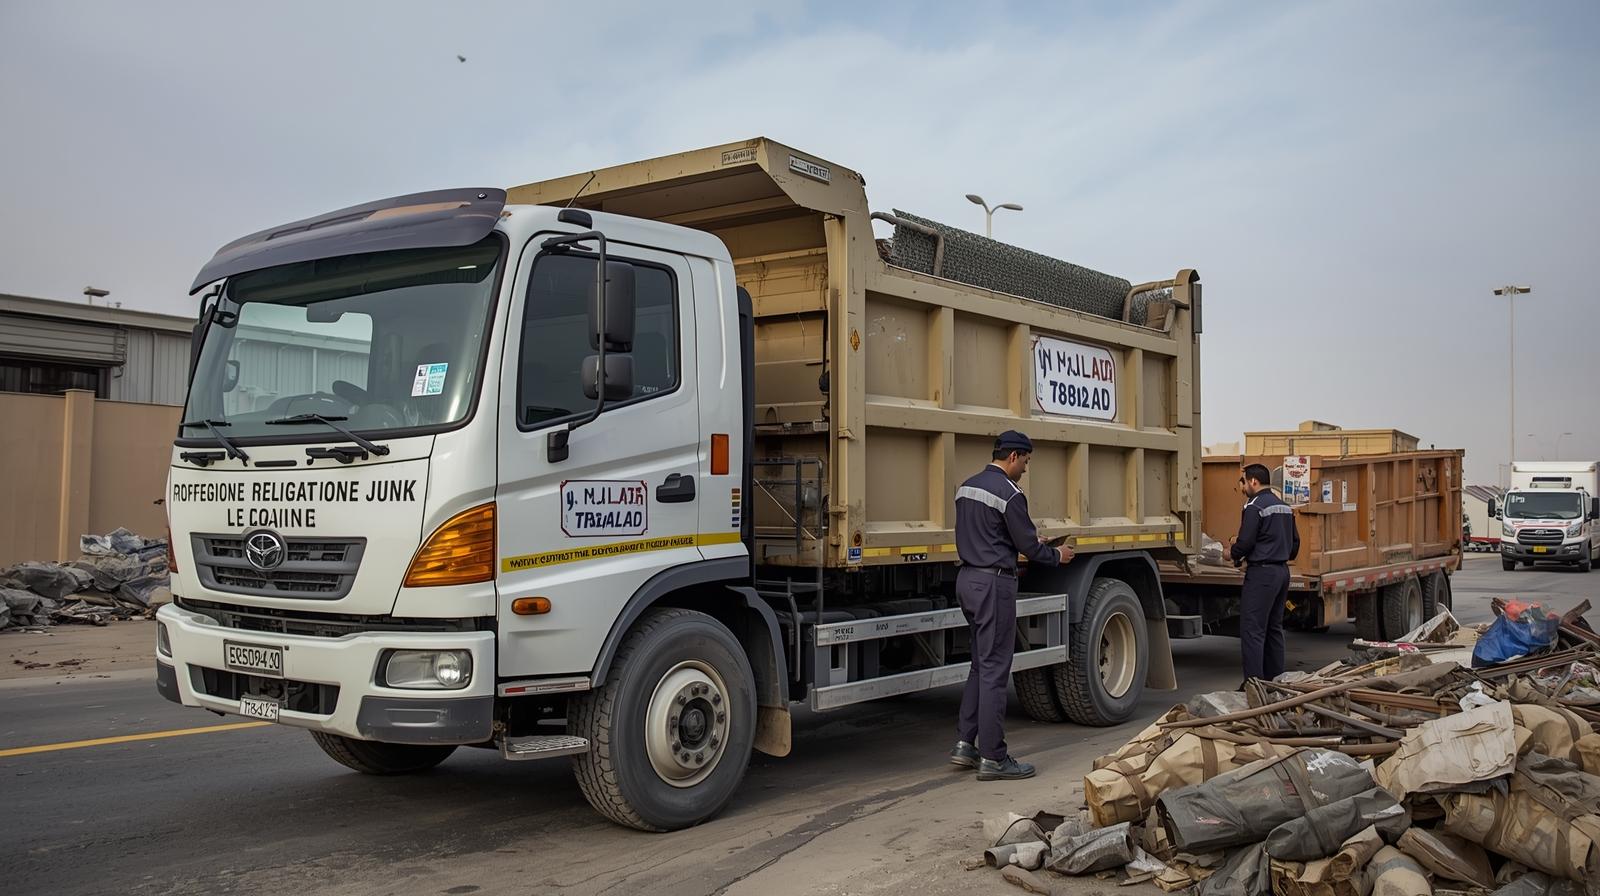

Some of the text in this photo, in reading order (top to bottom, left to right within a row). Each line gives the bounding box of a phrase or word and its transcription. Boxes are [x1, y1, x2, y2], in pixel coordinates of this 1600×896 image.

[173, 479, 417, 502] ROFFEGIONE RELIGATIONE JUNK
[227, 508, 245, 527] LE
